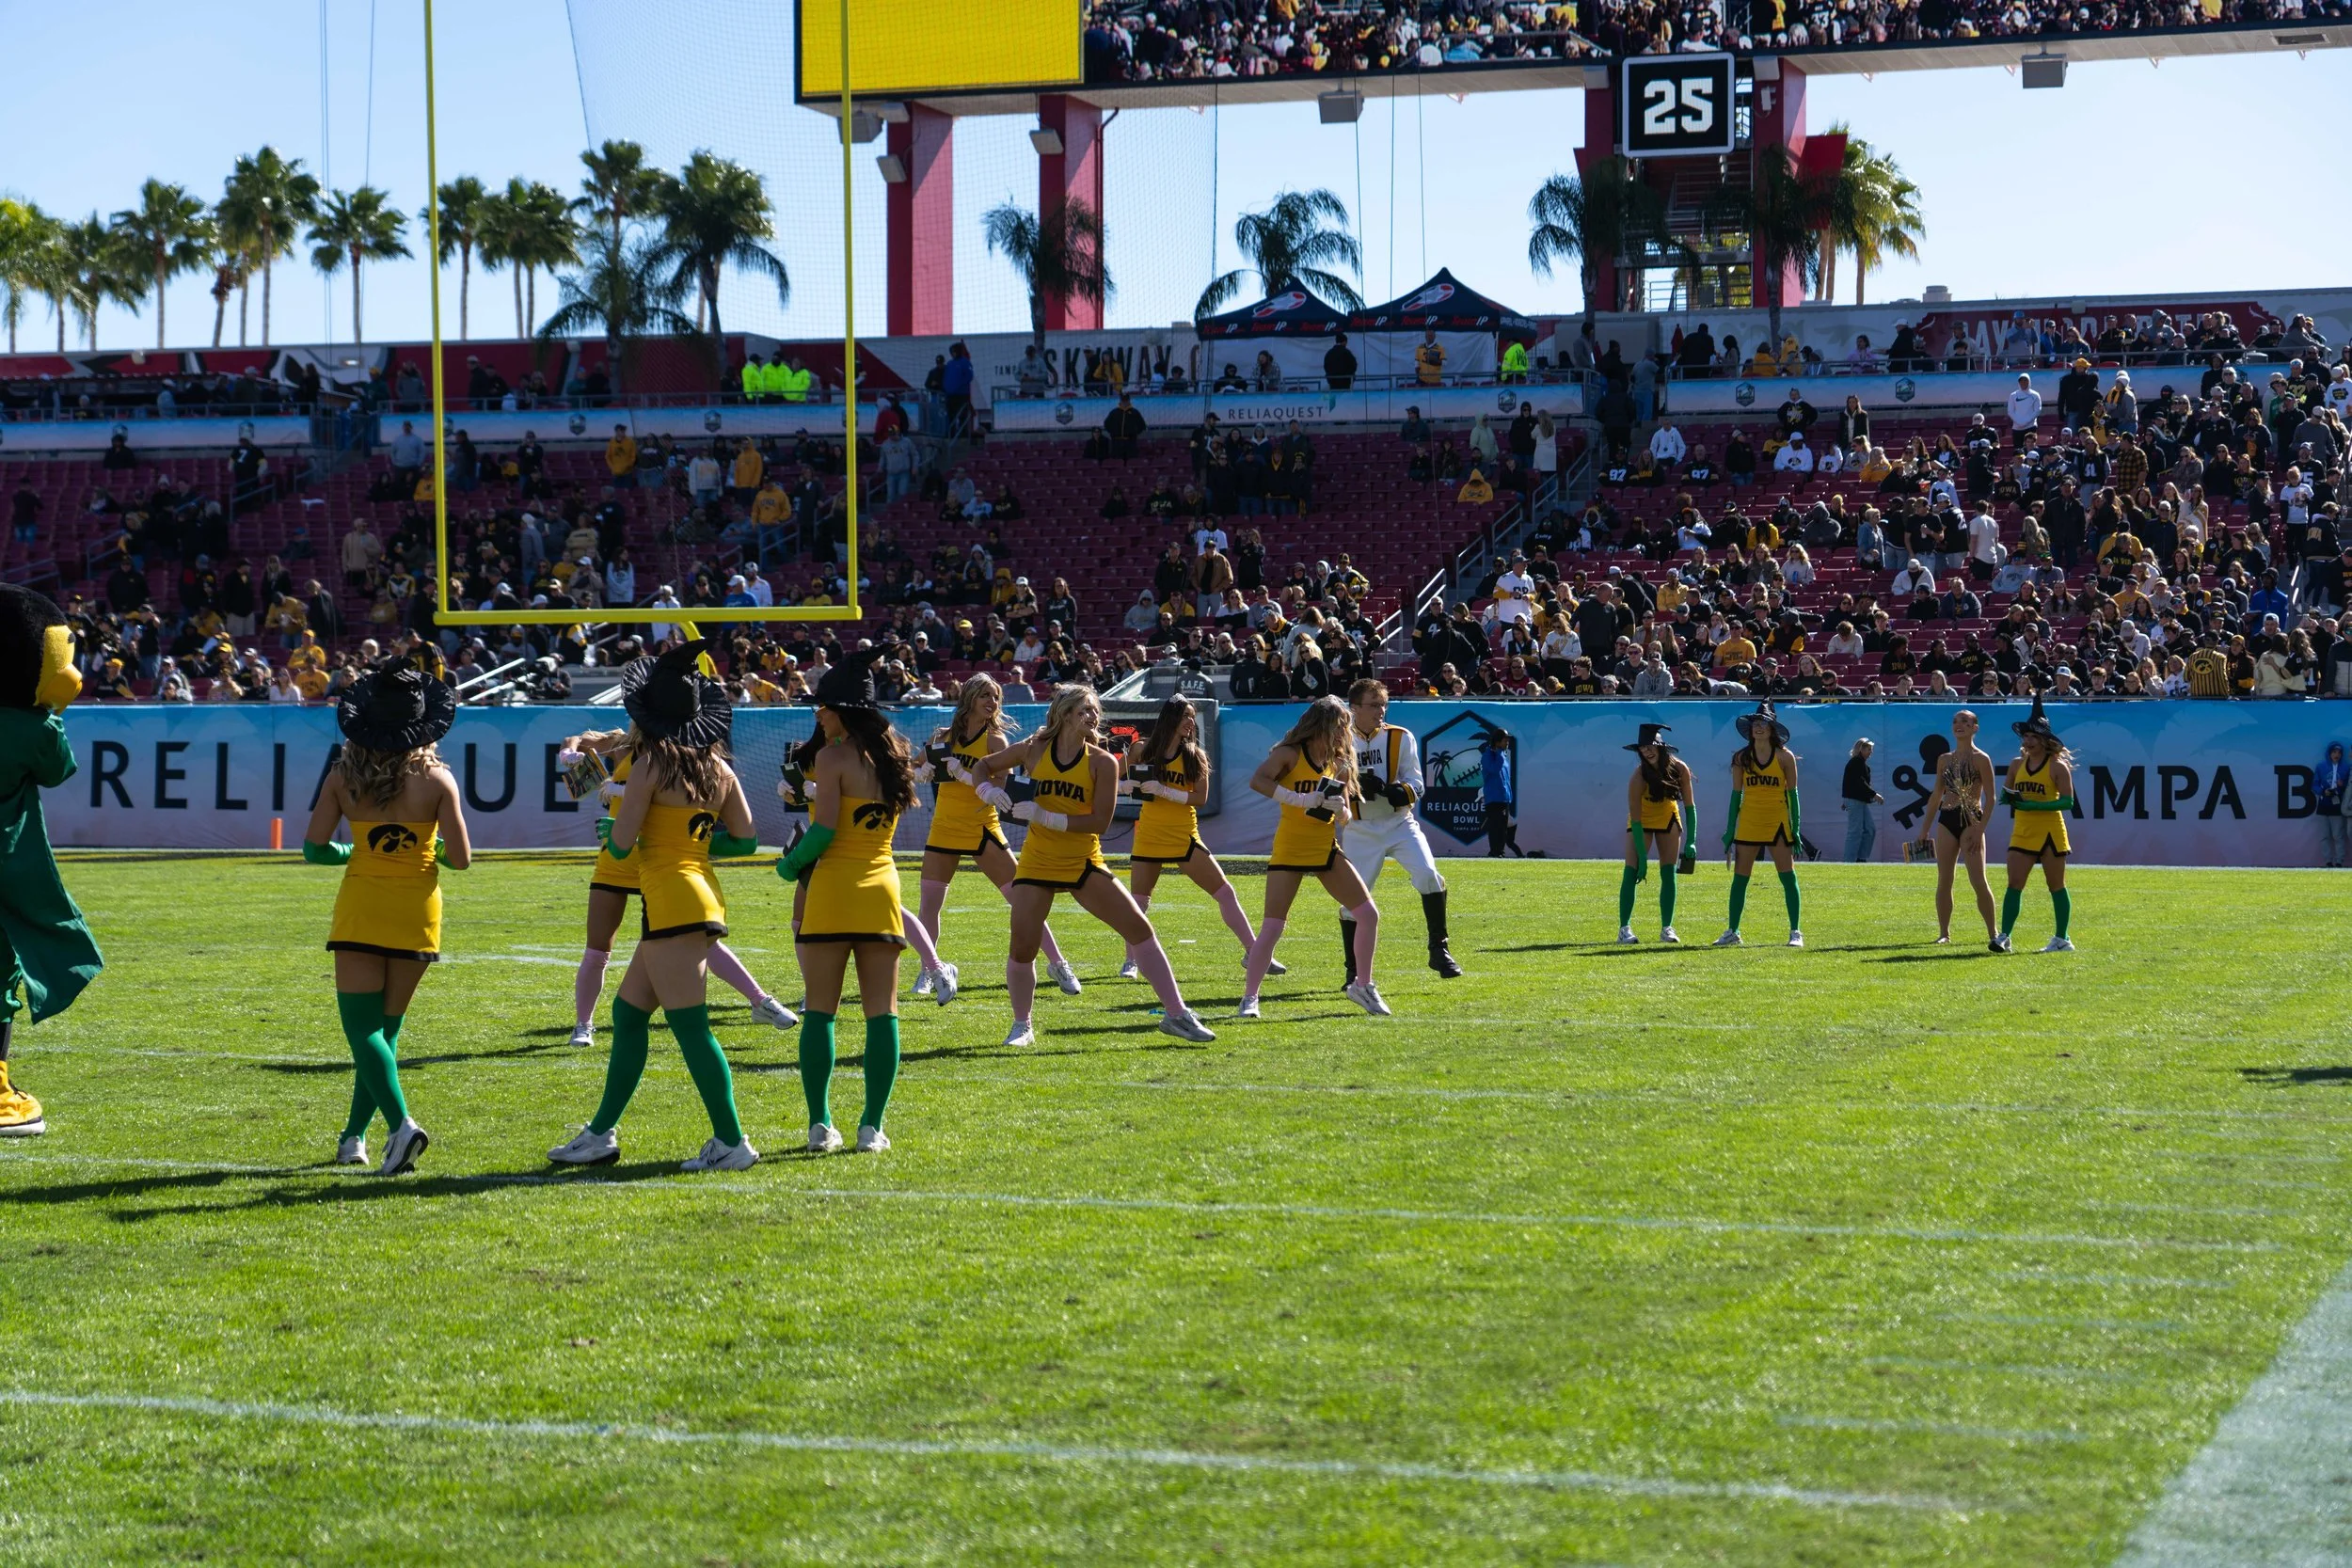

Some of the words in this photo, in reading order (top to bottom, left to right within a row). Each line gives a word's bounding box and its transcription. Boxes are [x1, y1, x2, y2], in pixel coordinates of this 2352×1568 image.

[1644, 77, 1713, 135] 25
[1228, 405, 1324, 420] RELIAQUEST
[1575, 684, 1595, 694] IOWA
[1745, 774, 1780, 787] IOWA
[1994, 765, 2248, 821] MPA
[1426, 801, 1486, 814] RELIAQUE
[1453, 816, 1480, 824] BOWL
